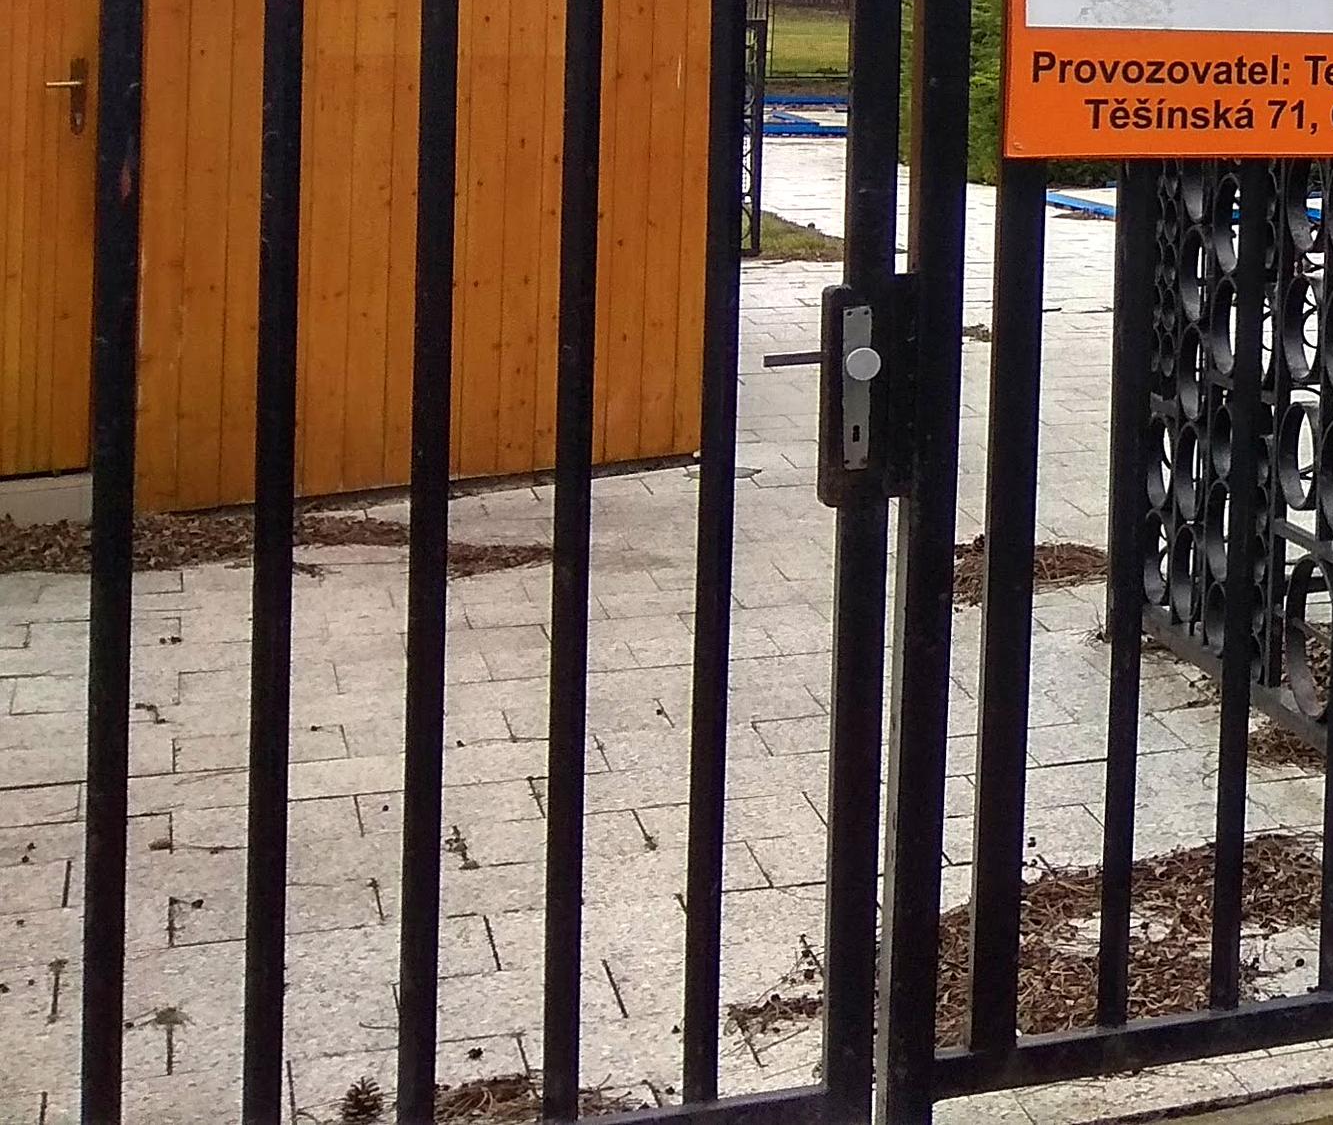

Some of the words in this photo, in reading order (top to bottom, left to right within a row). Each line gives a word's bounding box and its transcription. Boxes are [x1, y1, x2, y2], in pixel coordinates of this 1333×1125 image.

[1031, 50, 1291, 86] Provozovatel:
[1083, 97, 1255, 130] Těšínská
[1266, 99, 1318, 135] 71,
